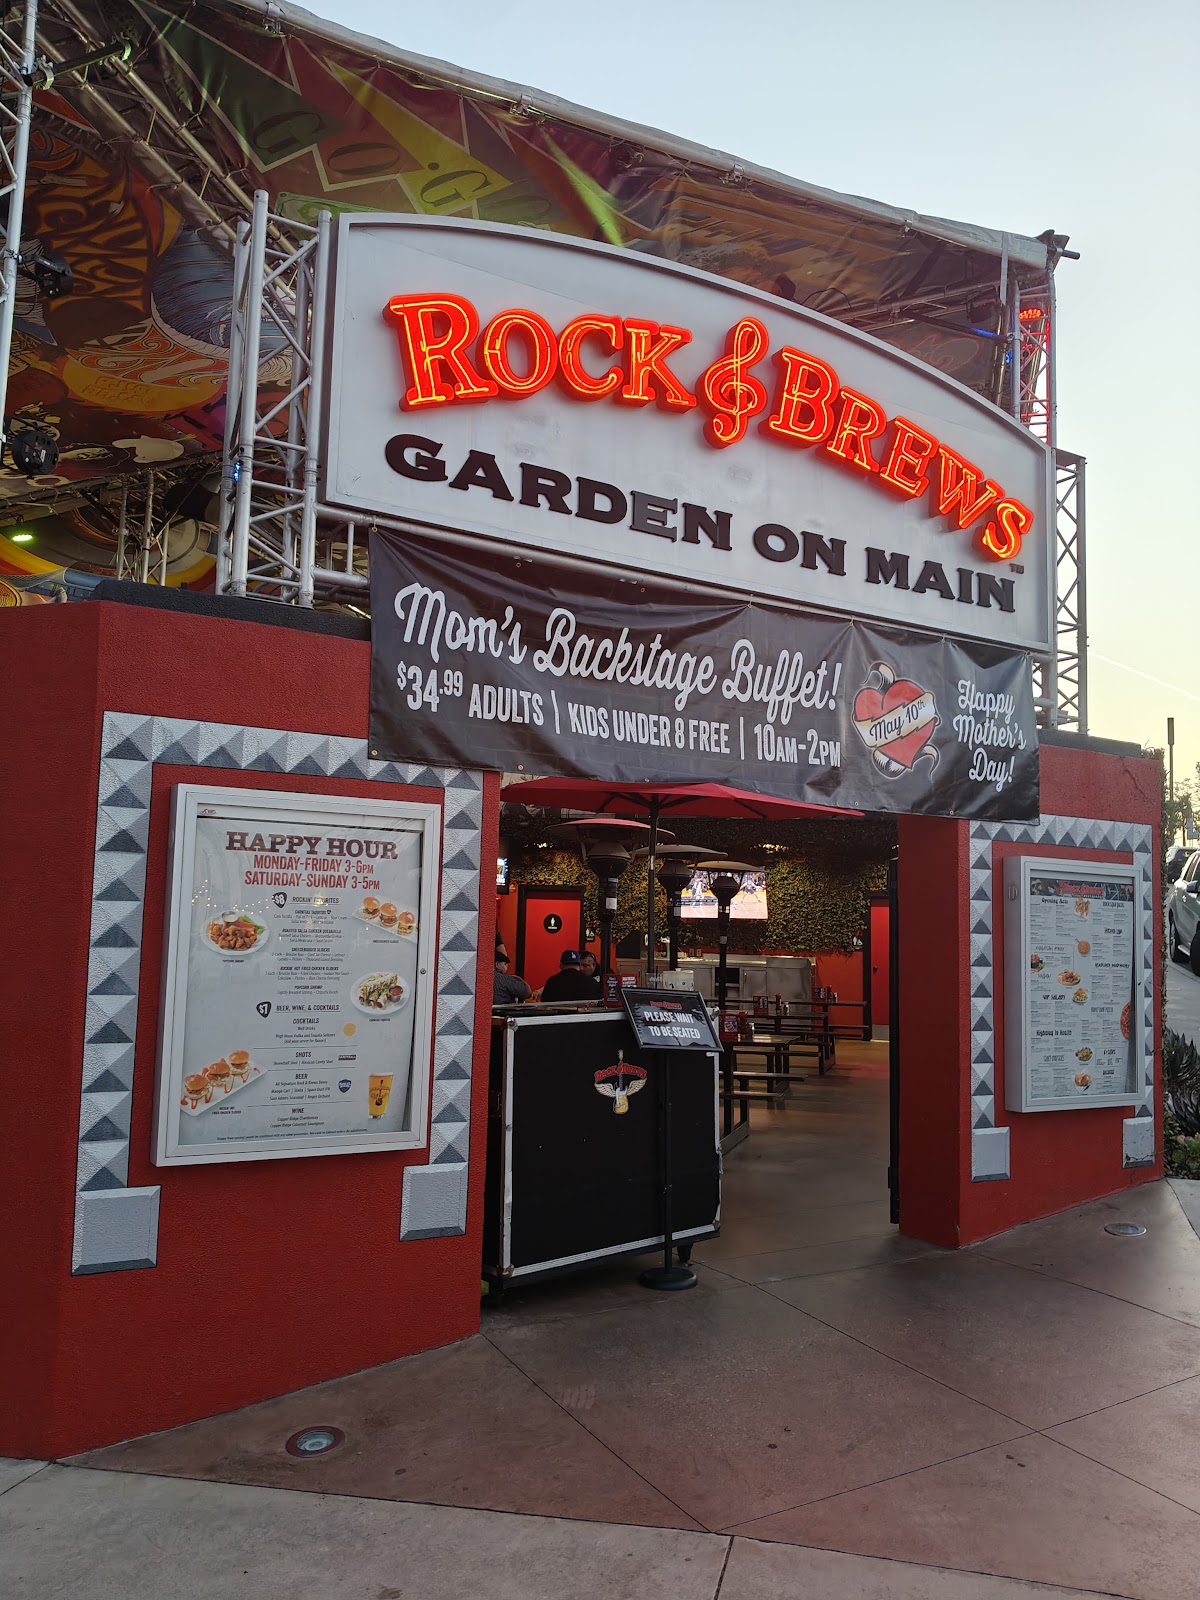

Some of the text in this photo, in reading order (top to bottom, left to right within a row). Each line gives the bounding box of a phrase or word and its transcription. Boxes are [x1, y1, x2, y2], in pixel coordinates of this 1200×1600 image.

[383, 293, 697, 413] ROCK
[759, 346, 1034, 560] BREWS
[385, 433, 1015, 613] GARDEN ON MAIN
[394, 582, 842, 725] Mom's Backstage Buffet!
[397, 660, 841, 768] $34.99 ADULTS KIDS UNDER 8 FREE 10AM-2PM
[869, 700, 926, 742] May 10th
[958, 679, 1015, 724] Happy
[953, 716, 1026, 751] Mother's
[968, 747, 1016, 793] Day!
[225, 830, 398, 860] HAPPY HOUR
[253, 855, 374, 874] MONDAY-FRIDAY 3-6PM
[244, 871, 380, 890] SATURDAY-SUNDAY 3-5PM
[644, 1011, 694, 1024] PLEASE WAIT
[648, 1026, 700, 1039] TO BE SEATED
